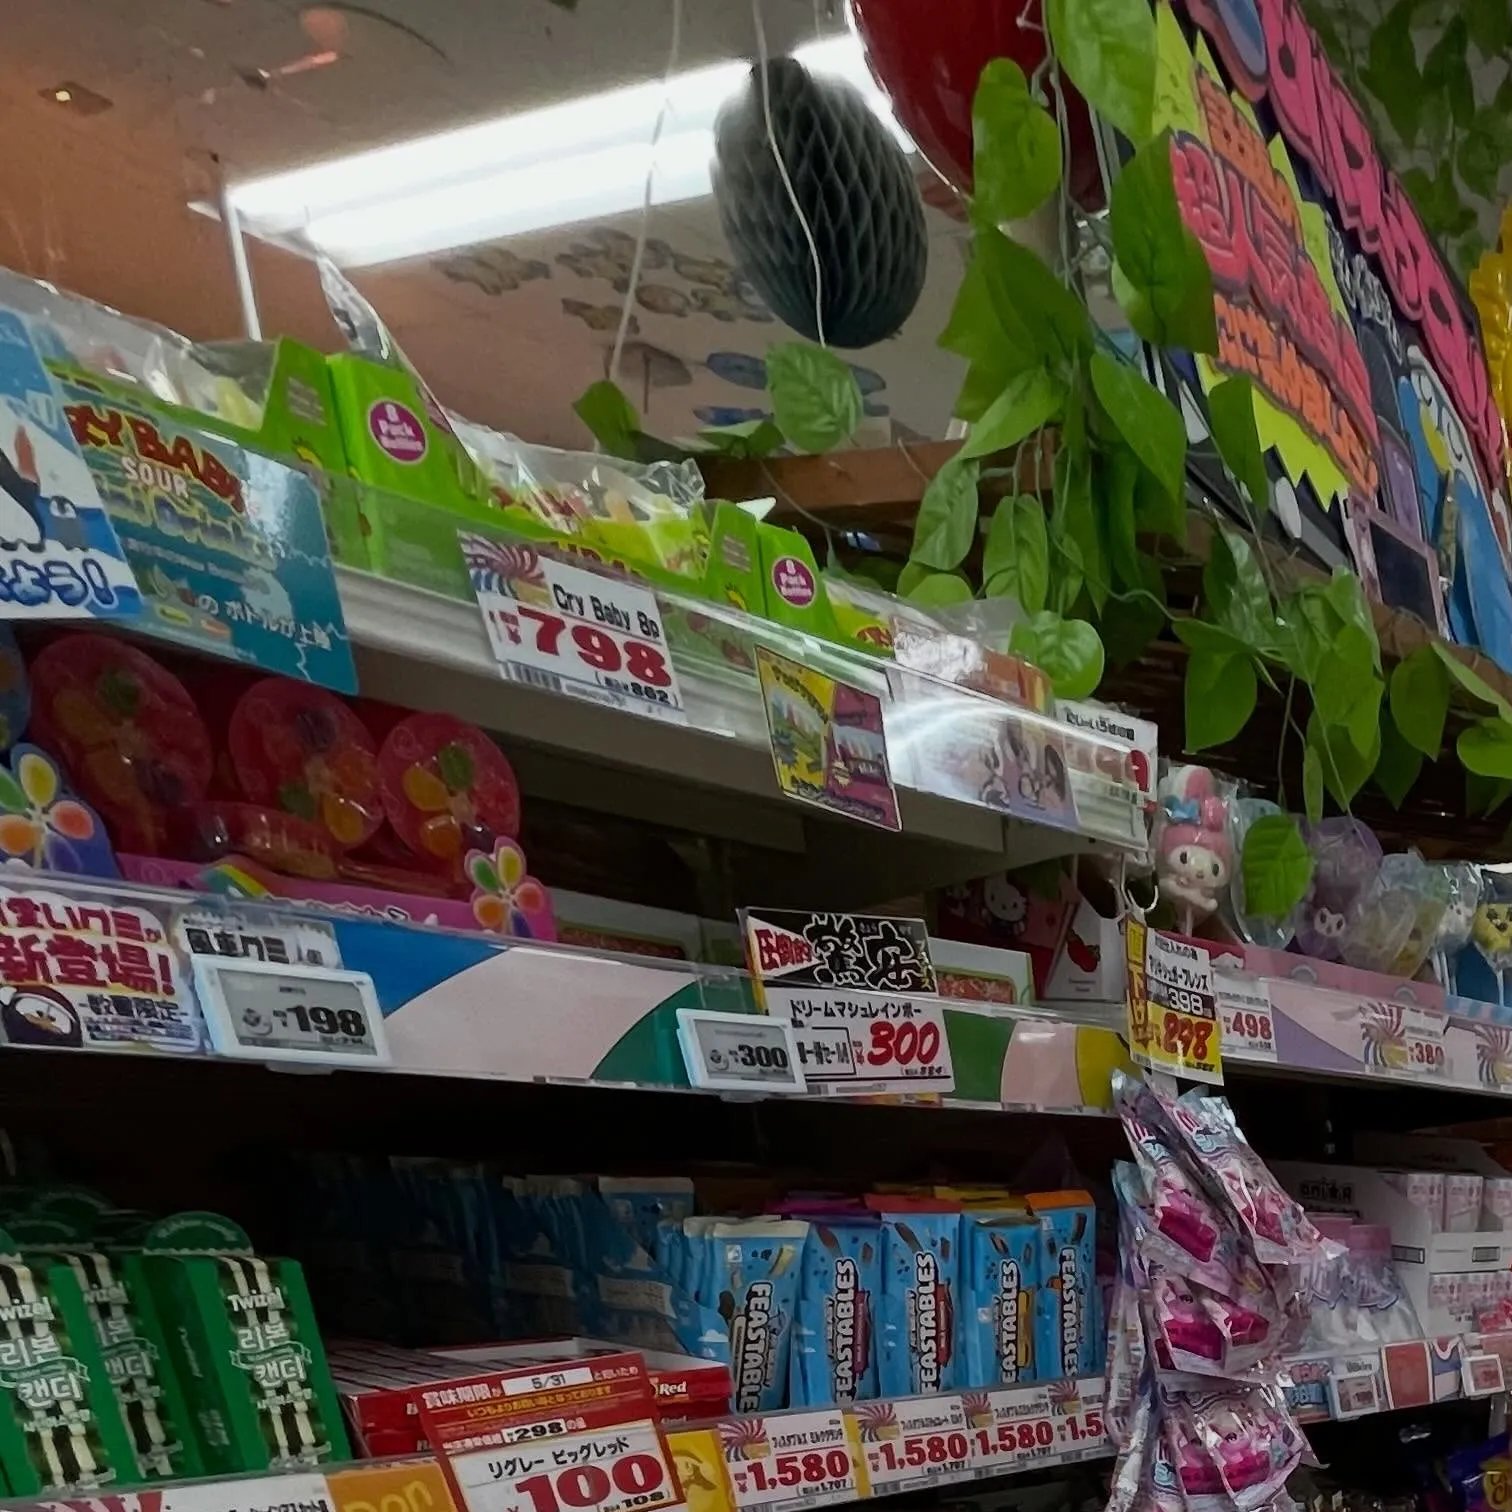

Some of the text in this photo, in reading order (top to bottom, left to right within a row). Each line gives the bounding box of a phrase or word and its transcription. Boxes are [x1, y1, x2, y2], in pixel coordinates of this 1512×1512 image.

[63, 405, 124, 446] RY
[121, 458, 190, 500] SOUR
[553, 583, 584, 616] Cry
[589, 595, 631, 631] Baby
[518, 606, 672, 687] 798
[1168, 987, 1203, 1016] 398
[285, 1005, 366, 1037] 198
[739, 1044, 788, 1069] 300
[867, 1021, 940, 1066] 300
[0, 1296, 55, 1321] wizel
[1001, 1258, 1019, 1383] EASTABLES
[1060, 1247, 1079, 1377] FEASTABLES
[239, 1323, 289, 1351] 리본
[736, 1280, 773, 1411] FEASTABLE
[17, 1372, 84, 1410] 캔디
[254, 1356, 307, 1389] 캔디
[531, 1373, 567, 1389] 5/31
[658, 1380, 688, 1396] Red
[514, 1422, 564, 1441] 298
[976, 1421, 1054, 1456] 1,580
[488, 1436, 631, 1480] リグレー ビッグレッド
[747, 1450, 850, 1491] 1,580
[880, 1434, 968, 1470] 1,580
